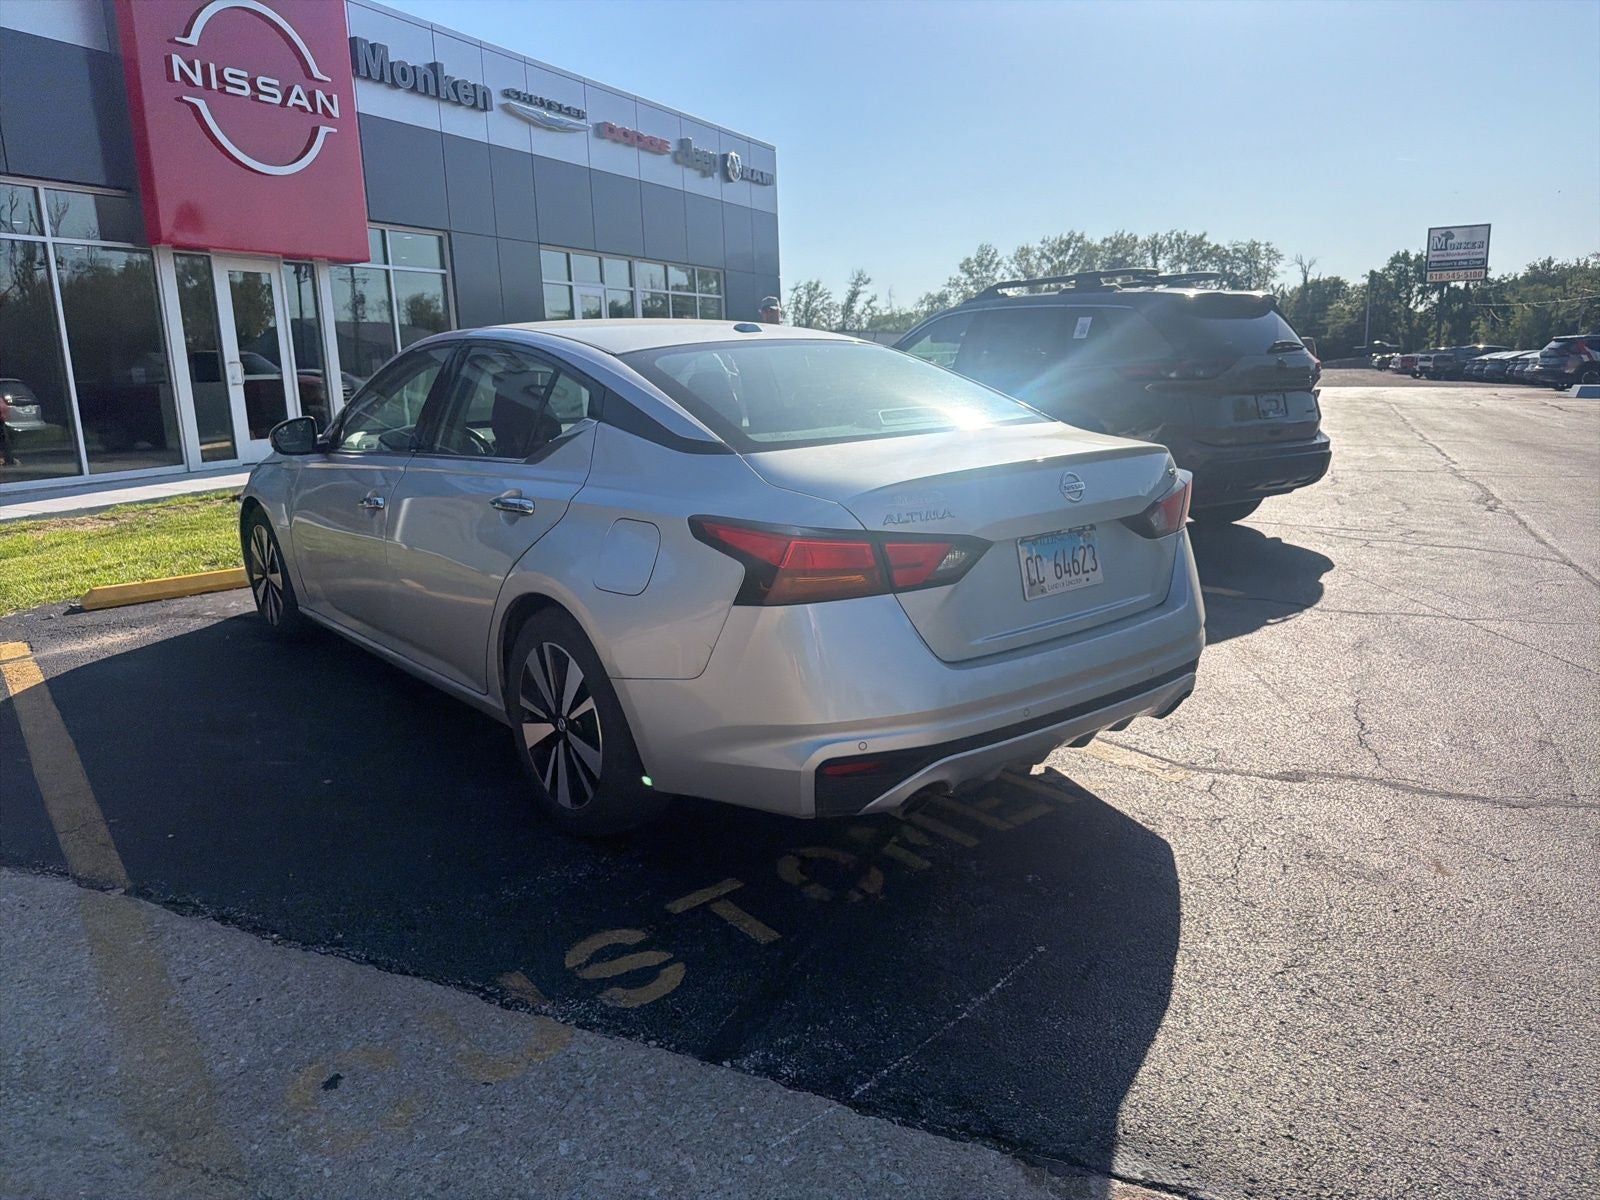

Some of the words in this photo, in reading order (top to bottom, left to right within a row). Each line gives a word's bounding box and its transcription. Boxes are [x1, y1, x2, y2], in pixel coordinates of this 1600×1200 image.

[170, 53, 339, 118] NISSAN
[351, 36, 494, 112] Monken
[501, 88, 587, 120] CHRYSLER
[596, 121, 671, 155] DODGE
[675, 137, 717, 178] Jeep
[742, 165, 774, 186] RAM
[882, 508, 956, 526] ALTIMA
[1025, 554, 1046, 586] CC
[1054, 544, 1098, 580] 64623
